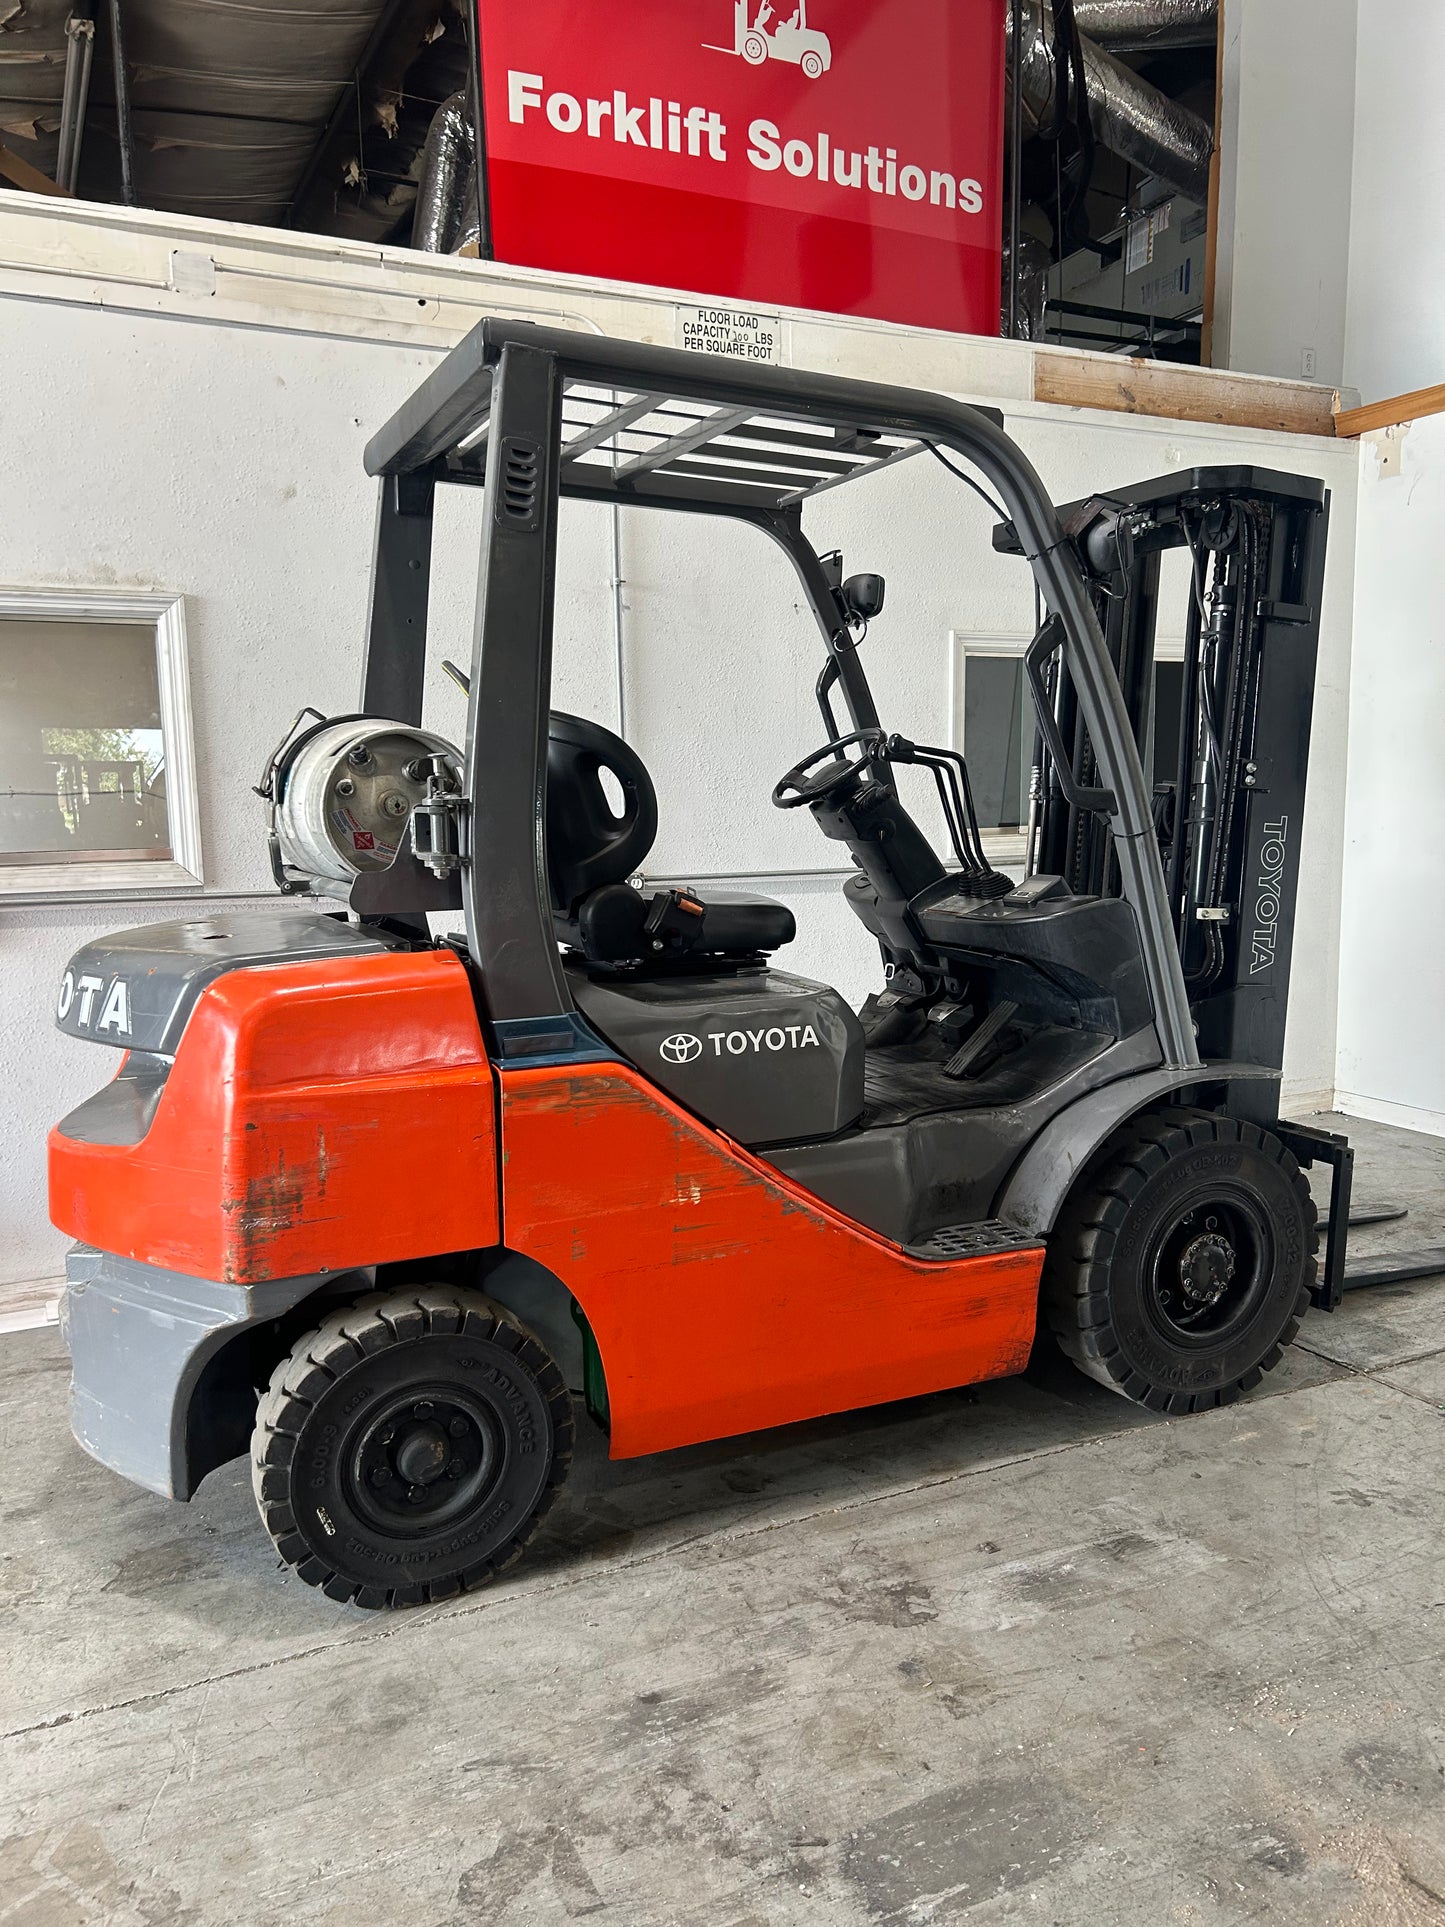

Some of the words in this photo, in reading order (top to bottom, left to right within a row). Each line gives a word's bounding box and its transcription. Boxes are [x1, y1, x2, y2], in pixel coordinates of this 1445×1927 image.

[507, 70, 727, 162] Forklift
[746, 118, 984, 214] Solutions
[683, 322, 731, 340] CAPACITY
[755, 332, 773, 346] LBS
[698, 310, 731, 326] FLOOR
[733, 314, 759, 330] LOAD
[684, 337, 704, 351] PER
[706, 340, 746, 356] SQUARE
[747, 345, 773, 360] FOOT
[1250, 815, 1289, 976] TOYOTA
[57, 970, 133, 1037] OTA
[707, 1024, 820, 1056] TOYOTA
[483, 1367, 537, 1454] ADVANCE
